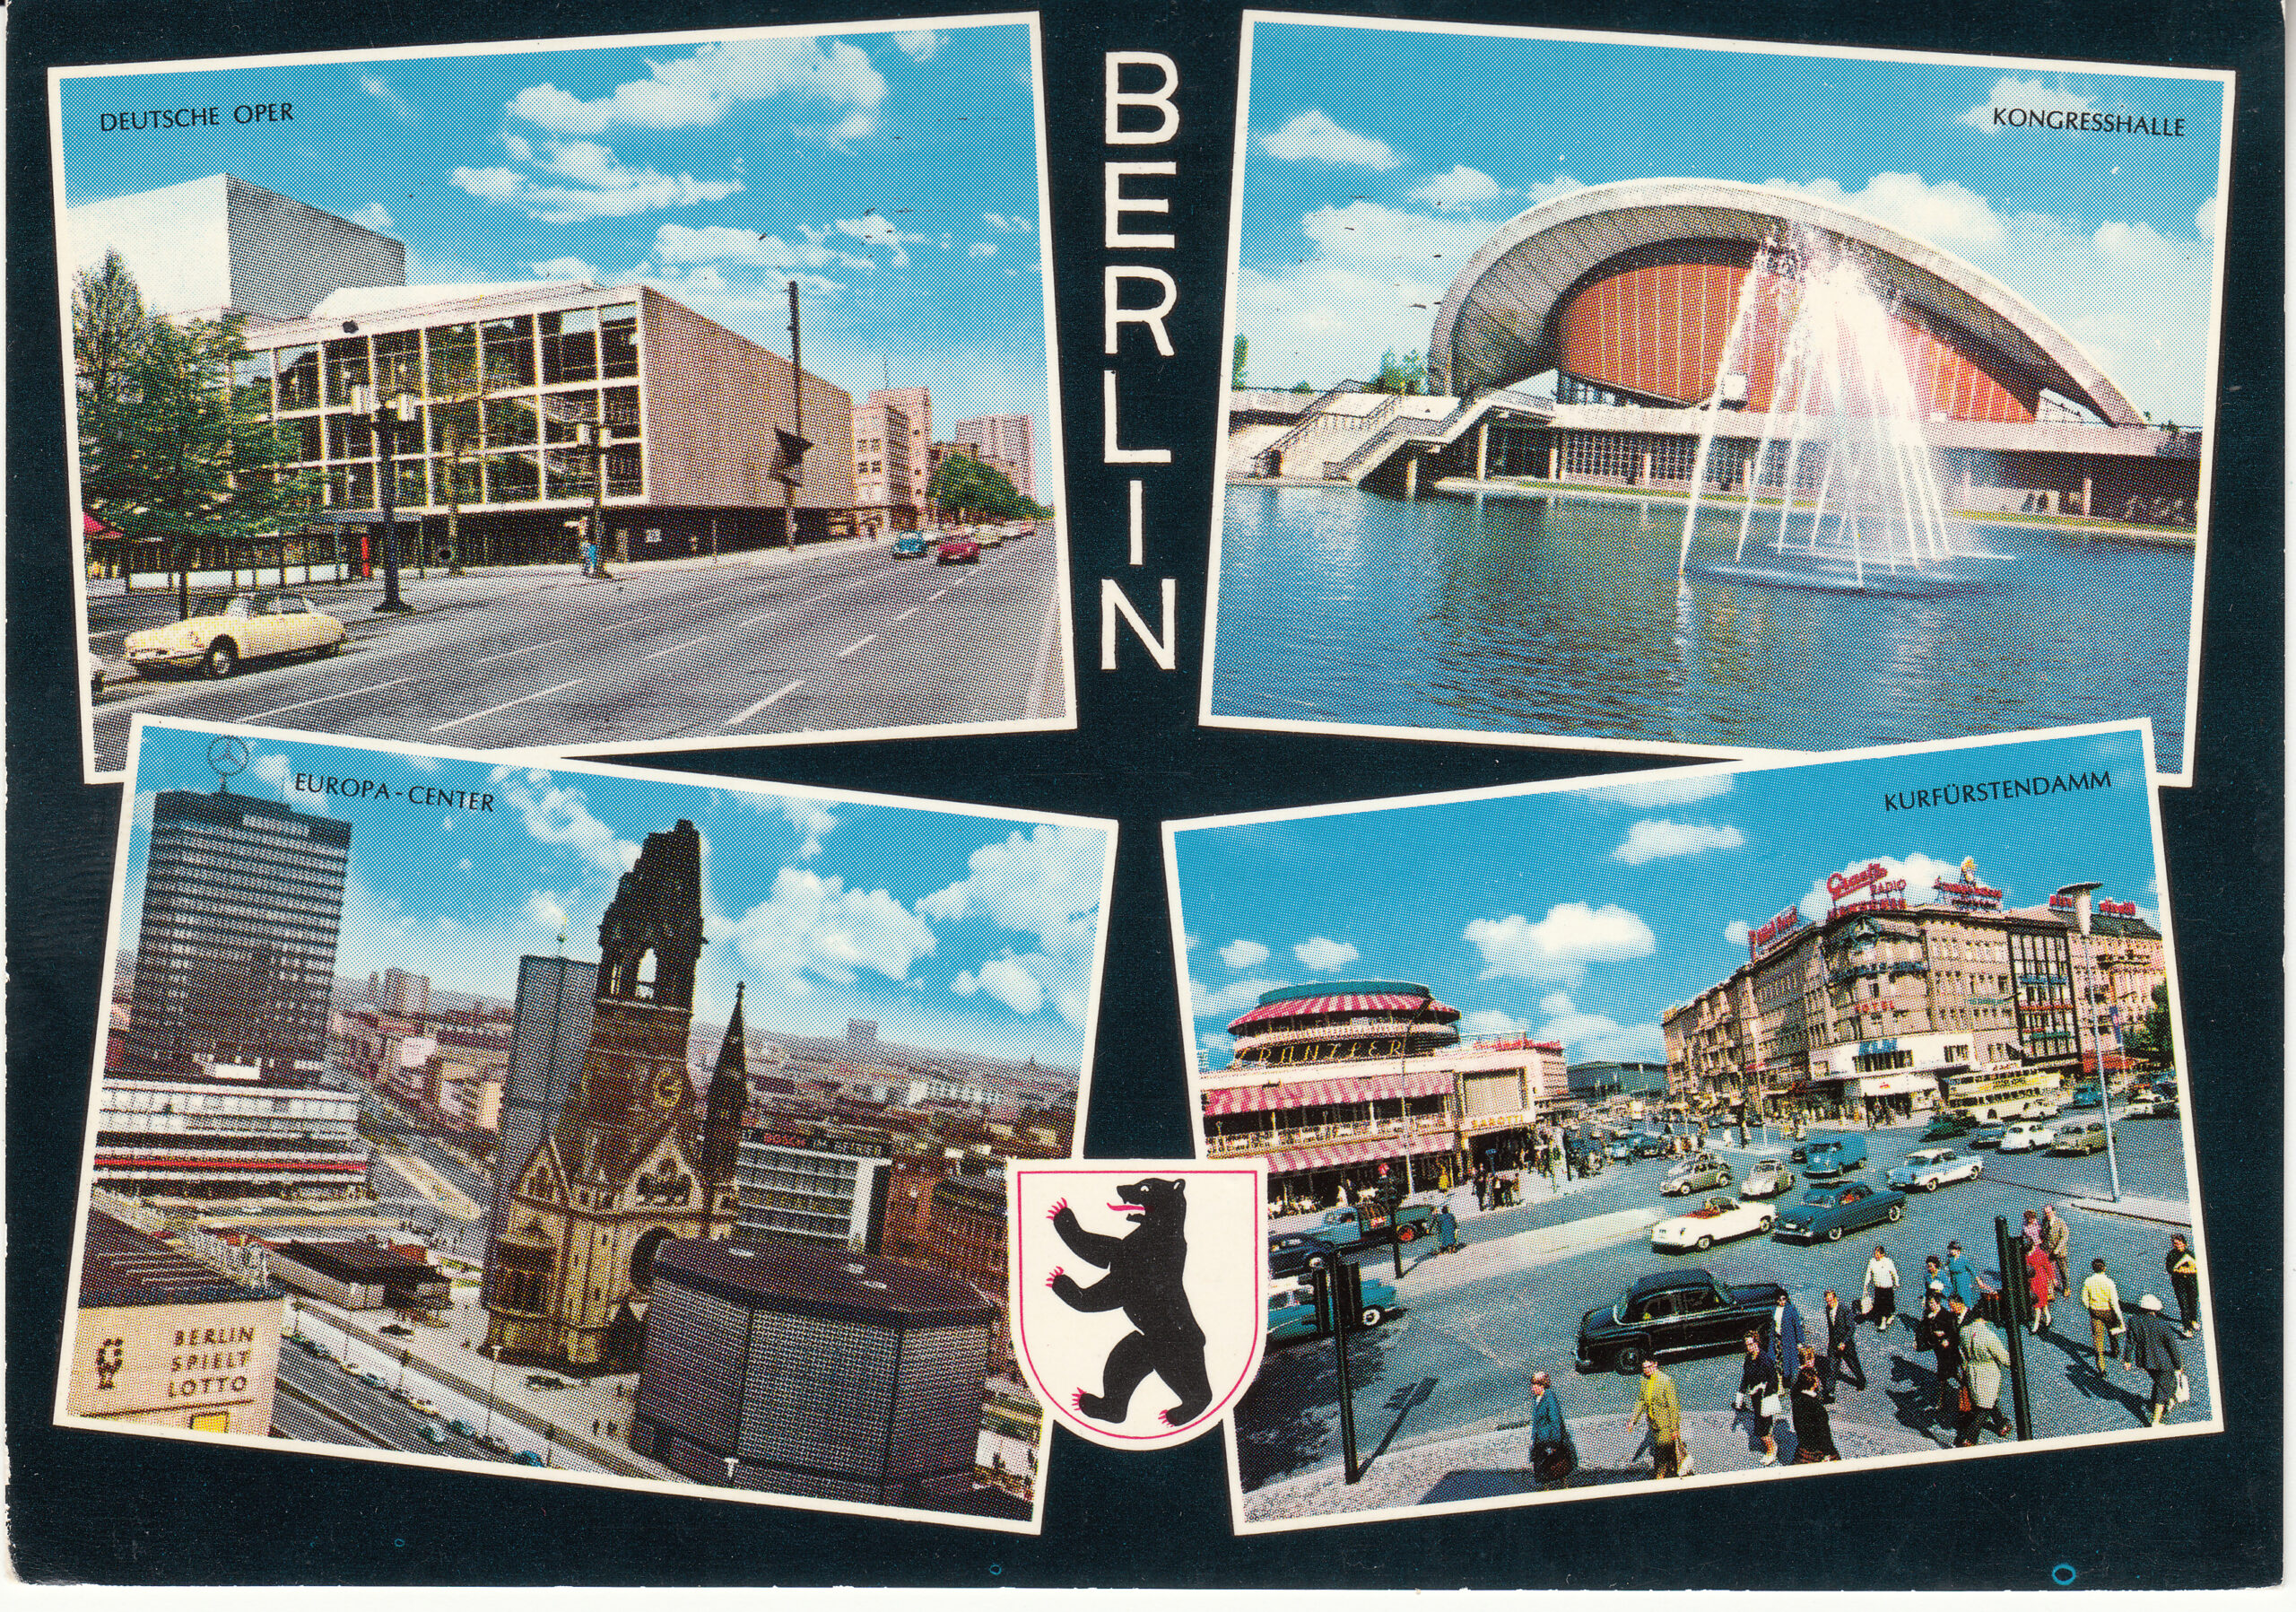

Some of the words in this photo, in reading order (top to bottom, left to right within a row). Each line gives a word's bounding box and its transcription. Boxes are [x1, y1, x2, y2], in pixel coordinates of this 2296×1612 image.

[1870, 878, 1907, 895] RADIO
[1858, 1038, 1898, 1056] KLM
[174, 1326, 255, 1346] BERLIN
[170, 1349, 251, 1372] SPIELT
[168, 1375, 248, 1399] LOTTO
